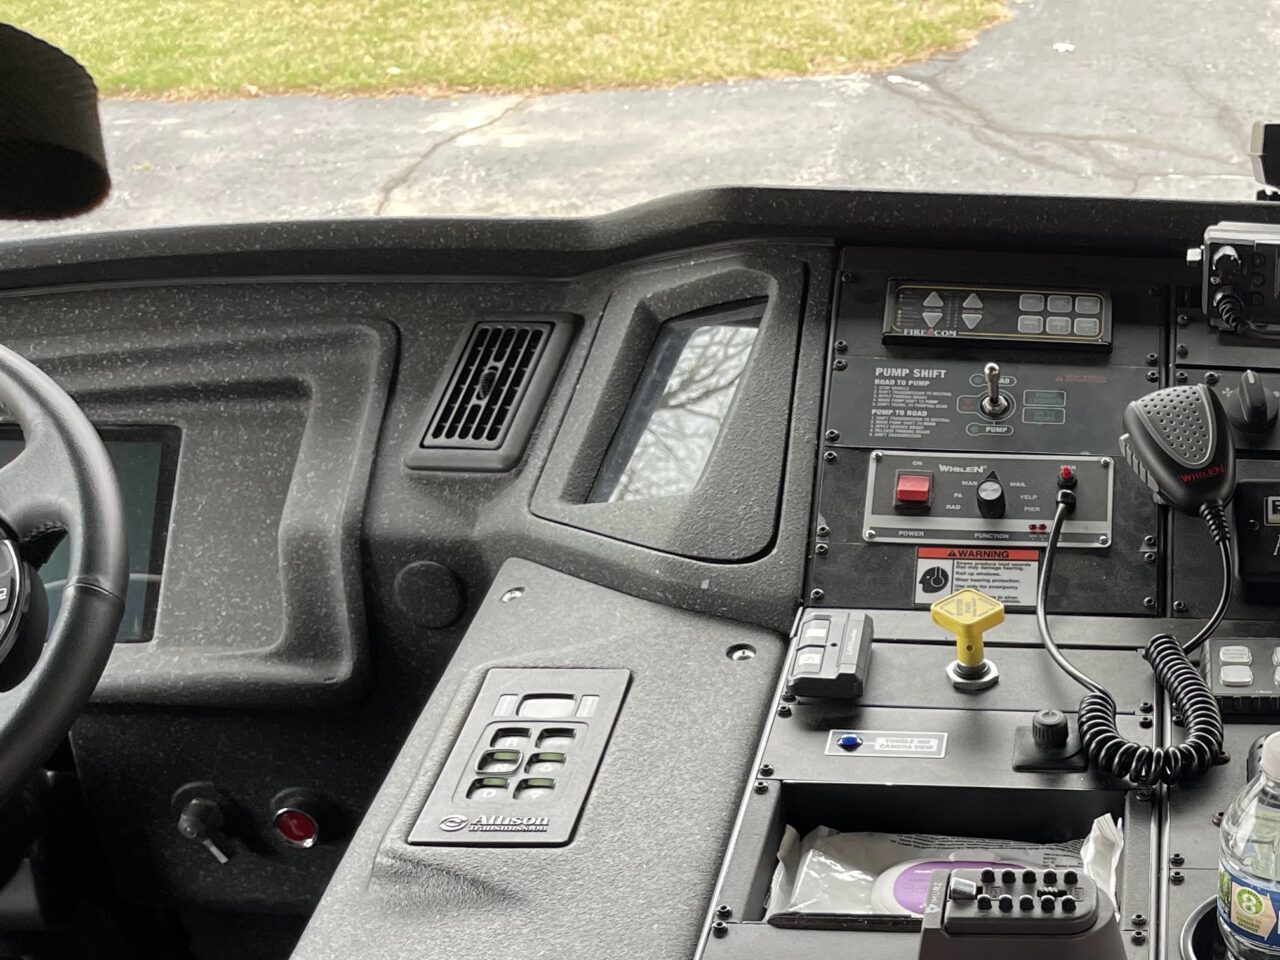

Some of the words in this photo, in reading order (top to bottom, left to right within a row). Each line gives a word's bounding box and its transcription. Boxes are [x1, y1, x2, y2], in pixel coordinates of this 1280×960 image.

[876, 368, 910, 376] PUMP
[913, 368, 947, 378] SHIFT
[958, 550, 1010, 558] WARNING
[470, 815, 549, 826] Allison
